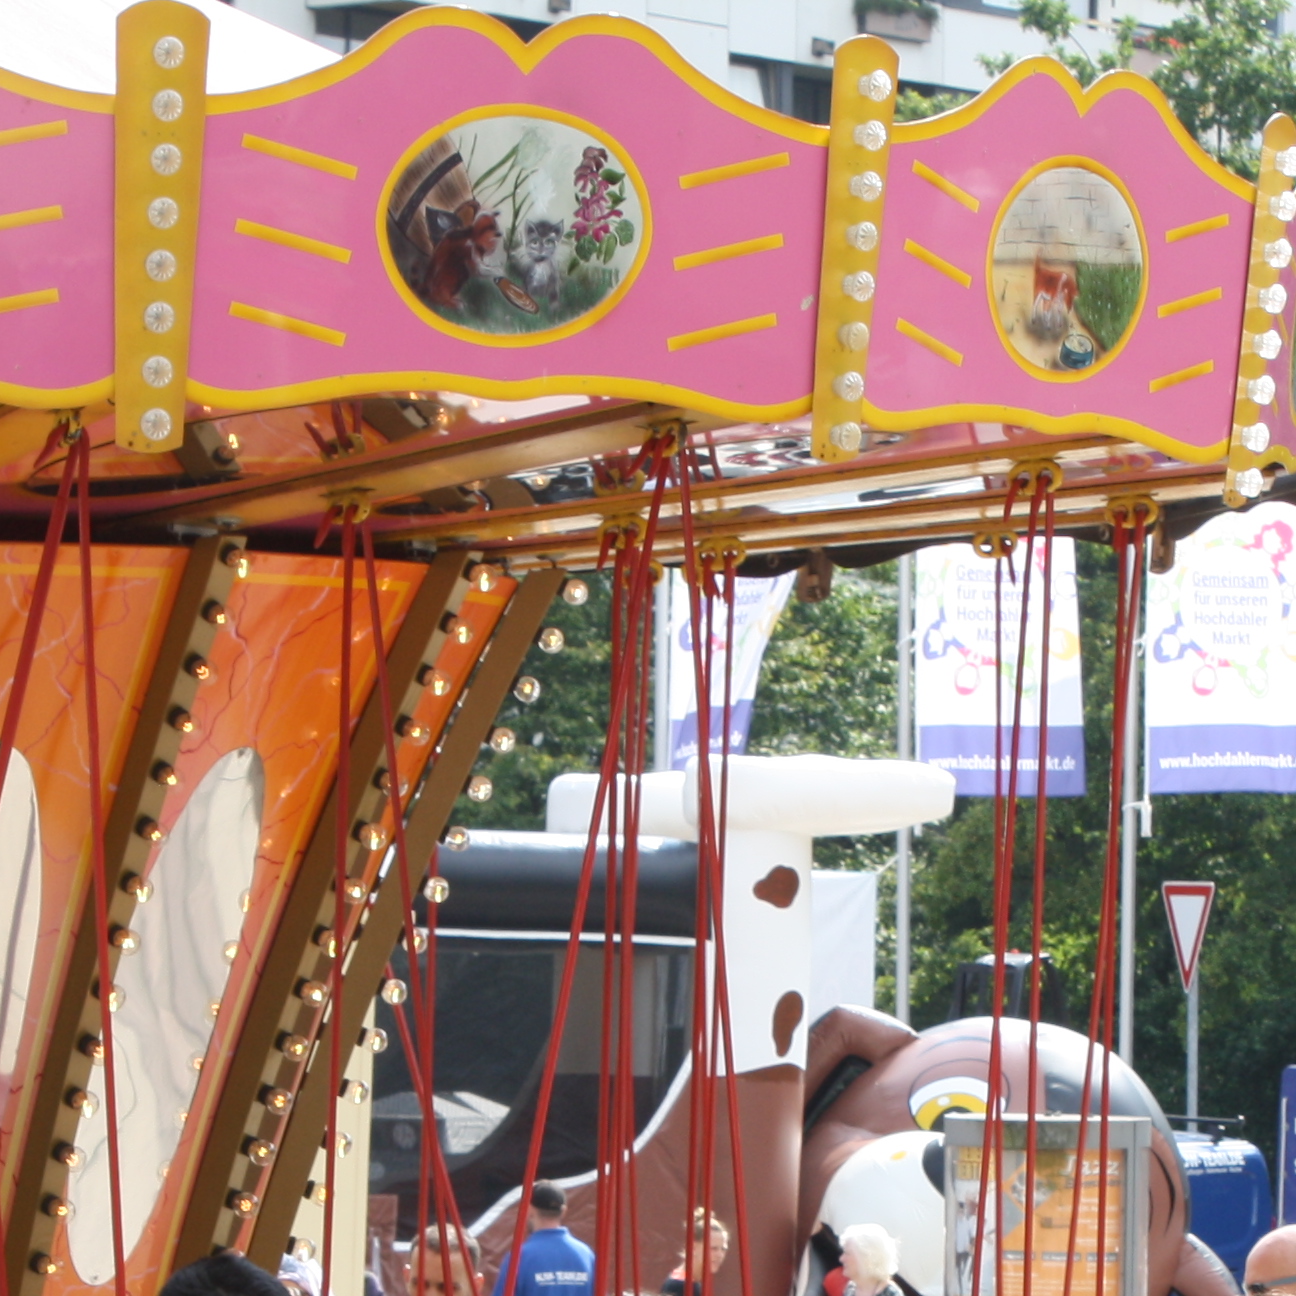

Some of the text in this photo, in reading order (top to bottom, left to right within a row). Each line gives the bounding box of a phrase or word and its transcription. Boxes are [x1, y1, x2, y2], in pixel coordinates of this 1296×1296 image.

[1192, 571, 1269, 588] Gemeinsam
[1194, 590, 1268, 607] für unseren
[1194, 611, 1268, 626] Hochdahler
[1212, 631, 1251, 645] Markt
